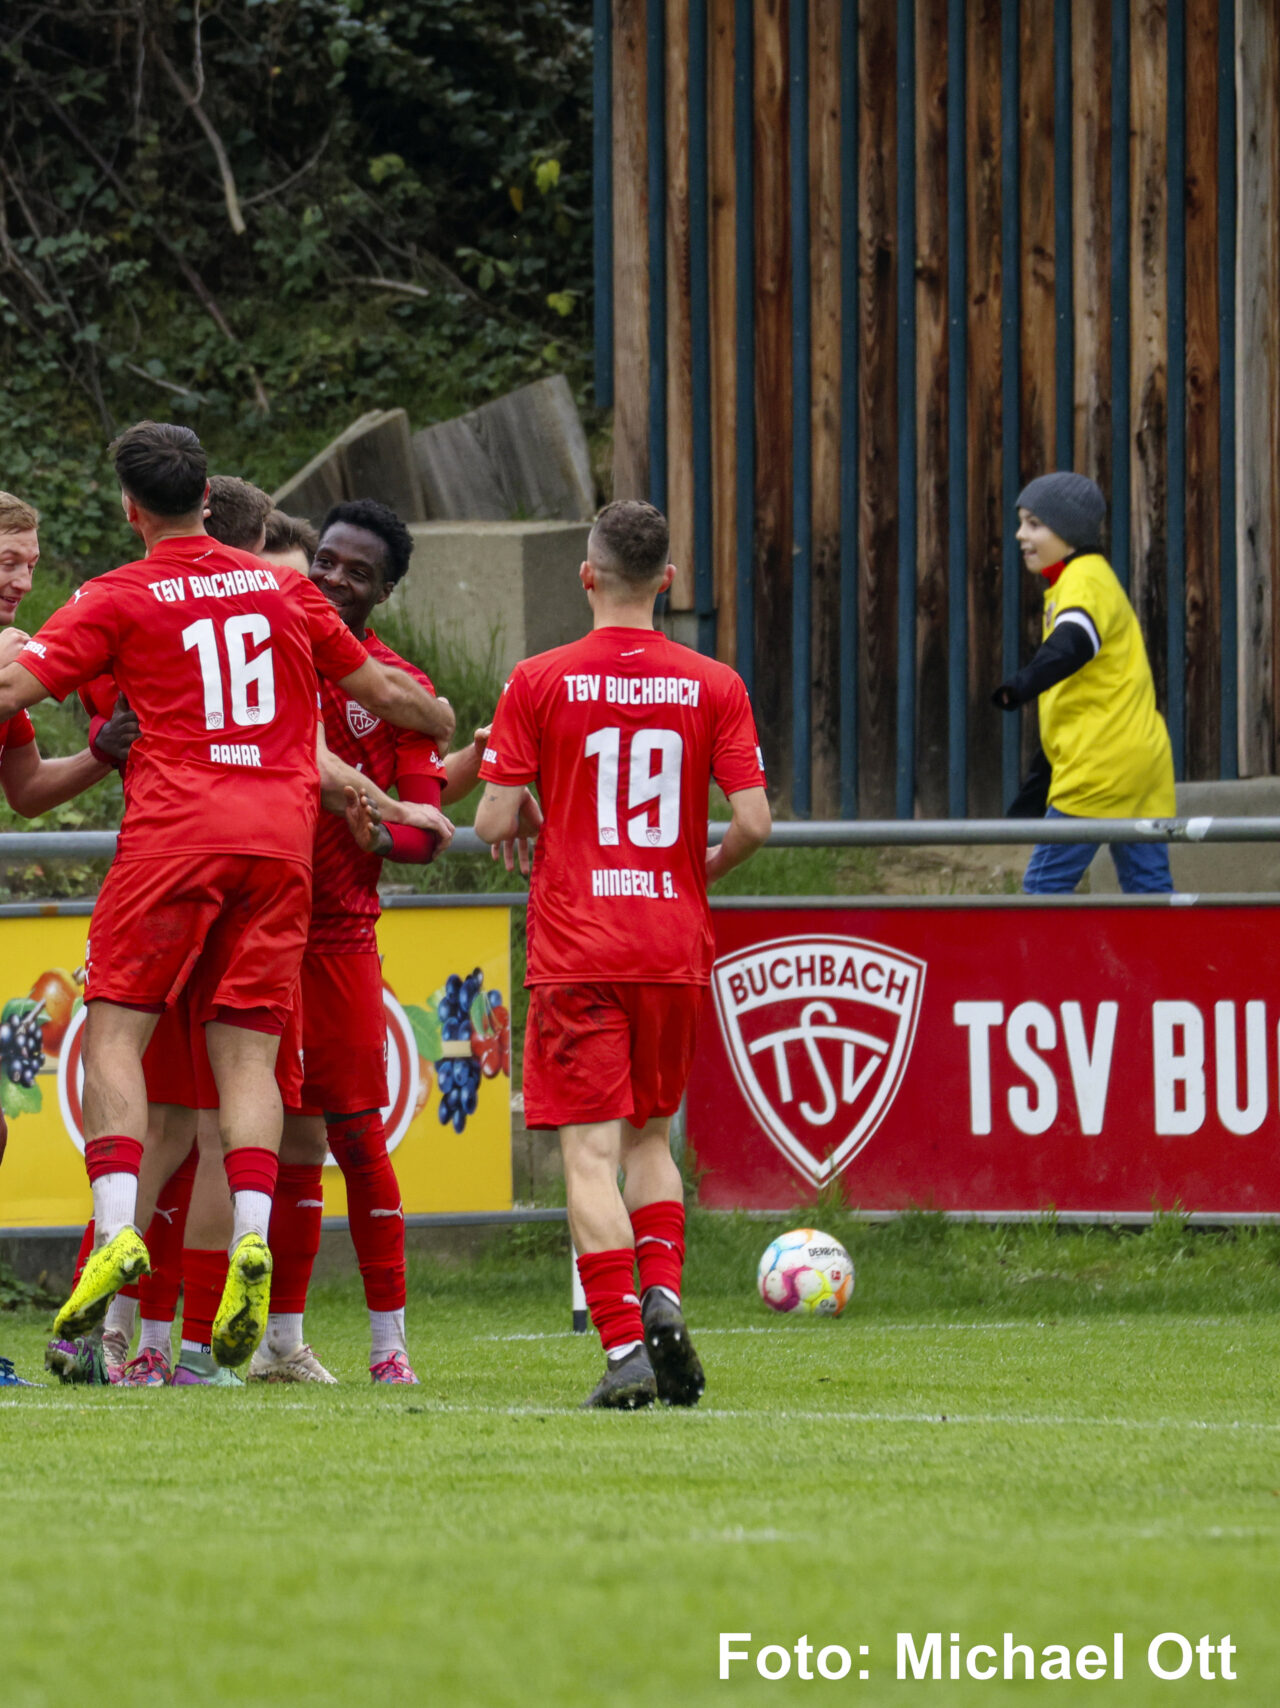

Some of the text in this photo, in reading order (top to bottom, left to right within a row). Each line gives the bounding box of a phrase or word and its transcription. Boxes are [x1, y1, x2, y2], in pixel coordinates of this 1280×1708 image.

[148, 569, 280, 602] TSV BUCHBACH
[181, 613, 276, 730] 16
[563, 674, 700, 707] TSV BUCHBACH
[584, 726, 683, 848] 19
[591, 869, 659, 898] HINGERL
[728, 954, 910, 1006] BUCHBACH
[748, 1001, 890, 1126] TSV
[953, 1000, 1280, 1136] TSV BU
